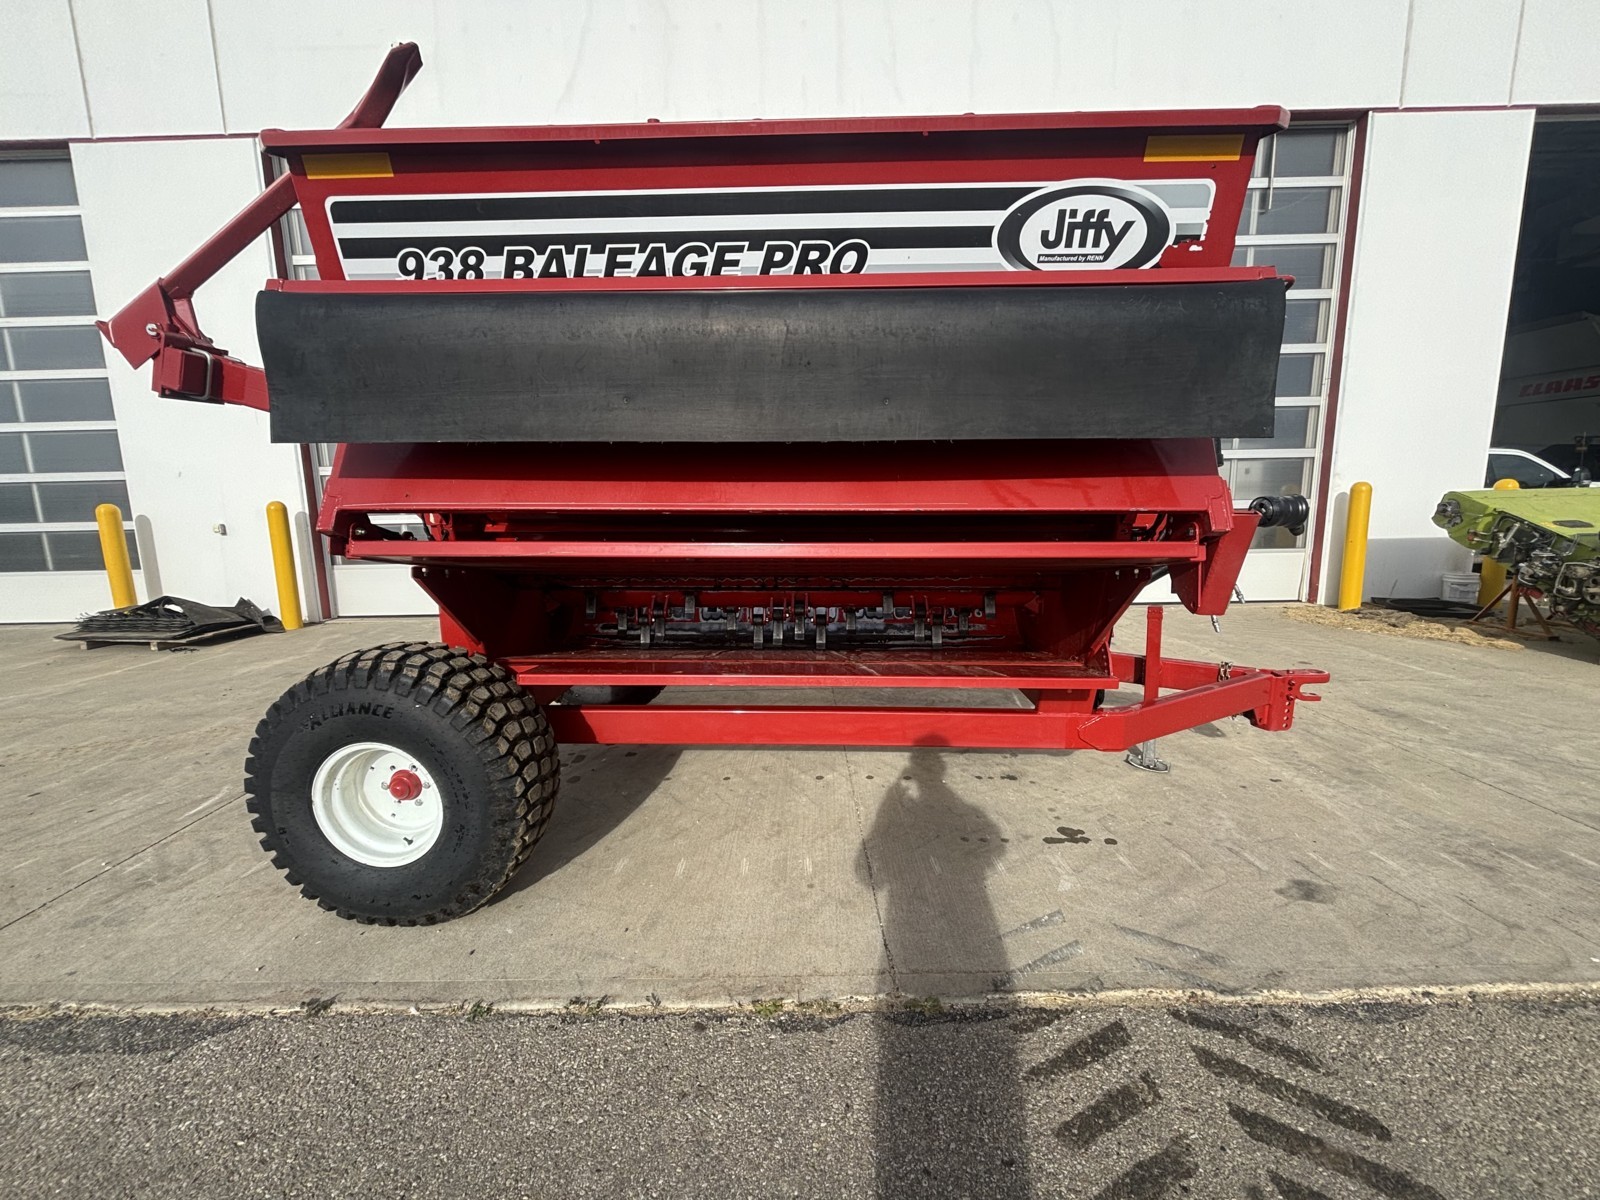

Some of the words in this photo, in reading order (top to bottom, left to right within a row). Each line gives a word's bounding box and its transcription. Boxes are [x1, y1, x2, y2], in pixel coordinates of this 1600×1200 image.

[1040, 209, 1136, 252] Jiffy
[397, 247, 486, 280] 938
[503, 242, 749, 279] BALEAGE
[759, 239, 870, 276] PRO
[1519, 376, 1600, 396] CLAAS
[309, 702, 395, 730] ALLIANCE
